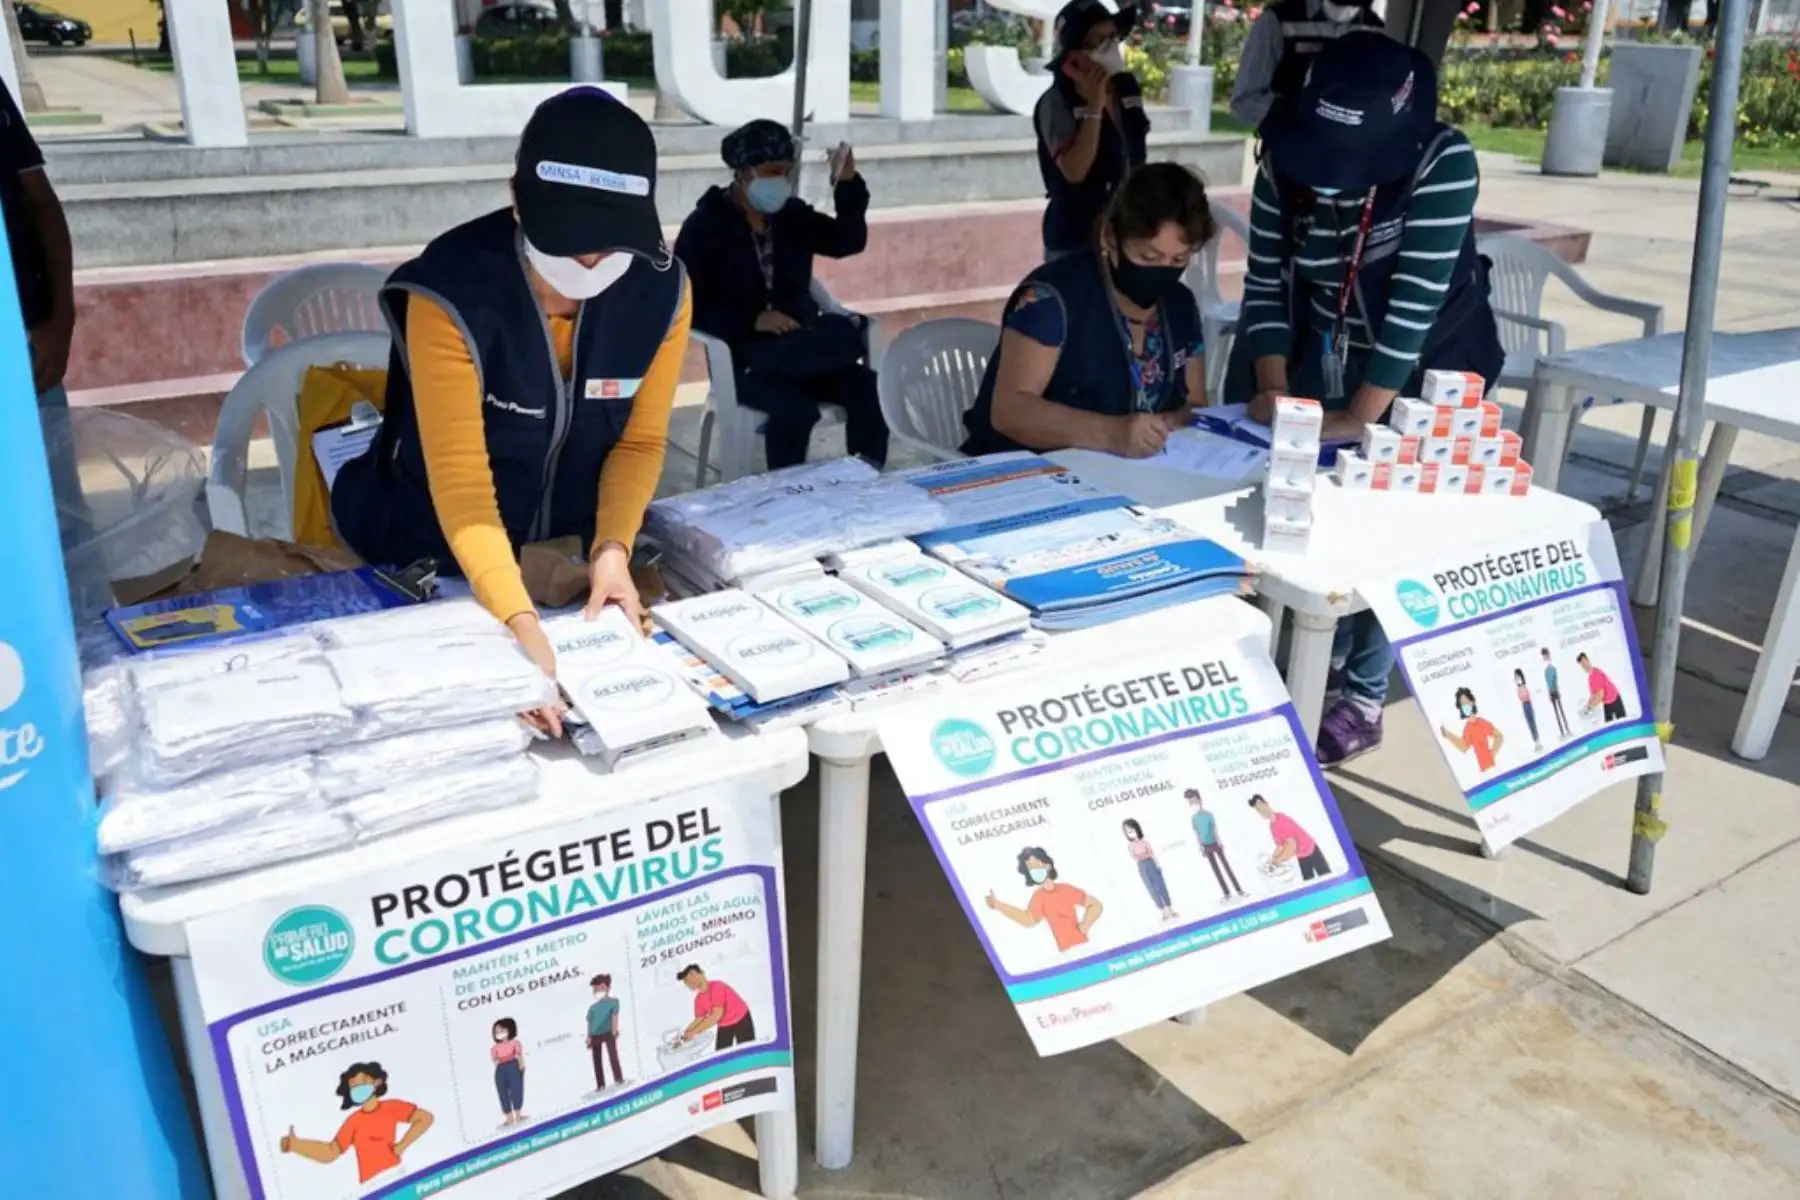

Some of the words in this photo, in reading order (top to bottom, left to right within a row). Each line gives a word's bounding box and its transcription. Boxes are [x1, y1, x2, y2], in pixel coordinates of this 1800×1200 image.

[540, 163, 581, 181] MINSA
[1433, 548, 1544, 593] PROTÉGETE
[1545, 540, 1582, 565] DEL
[1447, 562, 1588, 619] CORONAVIRUS
[997, 671, 1180, 734] PROTÉGETE
[1181, 660, 1239, 692] DEL
[1011, 686, 1249, 765] CORONAVIRUS
[1116, 789, 1137, 804] LOS
[371, 828, 634, 928] PROTÉGETE
[645, 806, 721, 853] DEL
[374, 837, 724, 965] CORONAVIRUS
[637, 914, 688, 939] MANOS
[690, 903, 720, 921] CON
[722, 895, 761, 910] AGUA
[289, 930, 349, 962] SALUD
[535, 932, 588, 957] METRO
[640, 954, 658, 969] 20
[454, 981, 477, 997] DE
[479, 957, 560, 990] DISTANCIA
[457, 993, 493, 1012] CON
[496, 983, 525, 1001] LOS
[257, 1016, 292, 1038] USA
[261, 1001, 407, 1056] CORRECTAMENTE
[265, 1057, 287, 1074] LA
